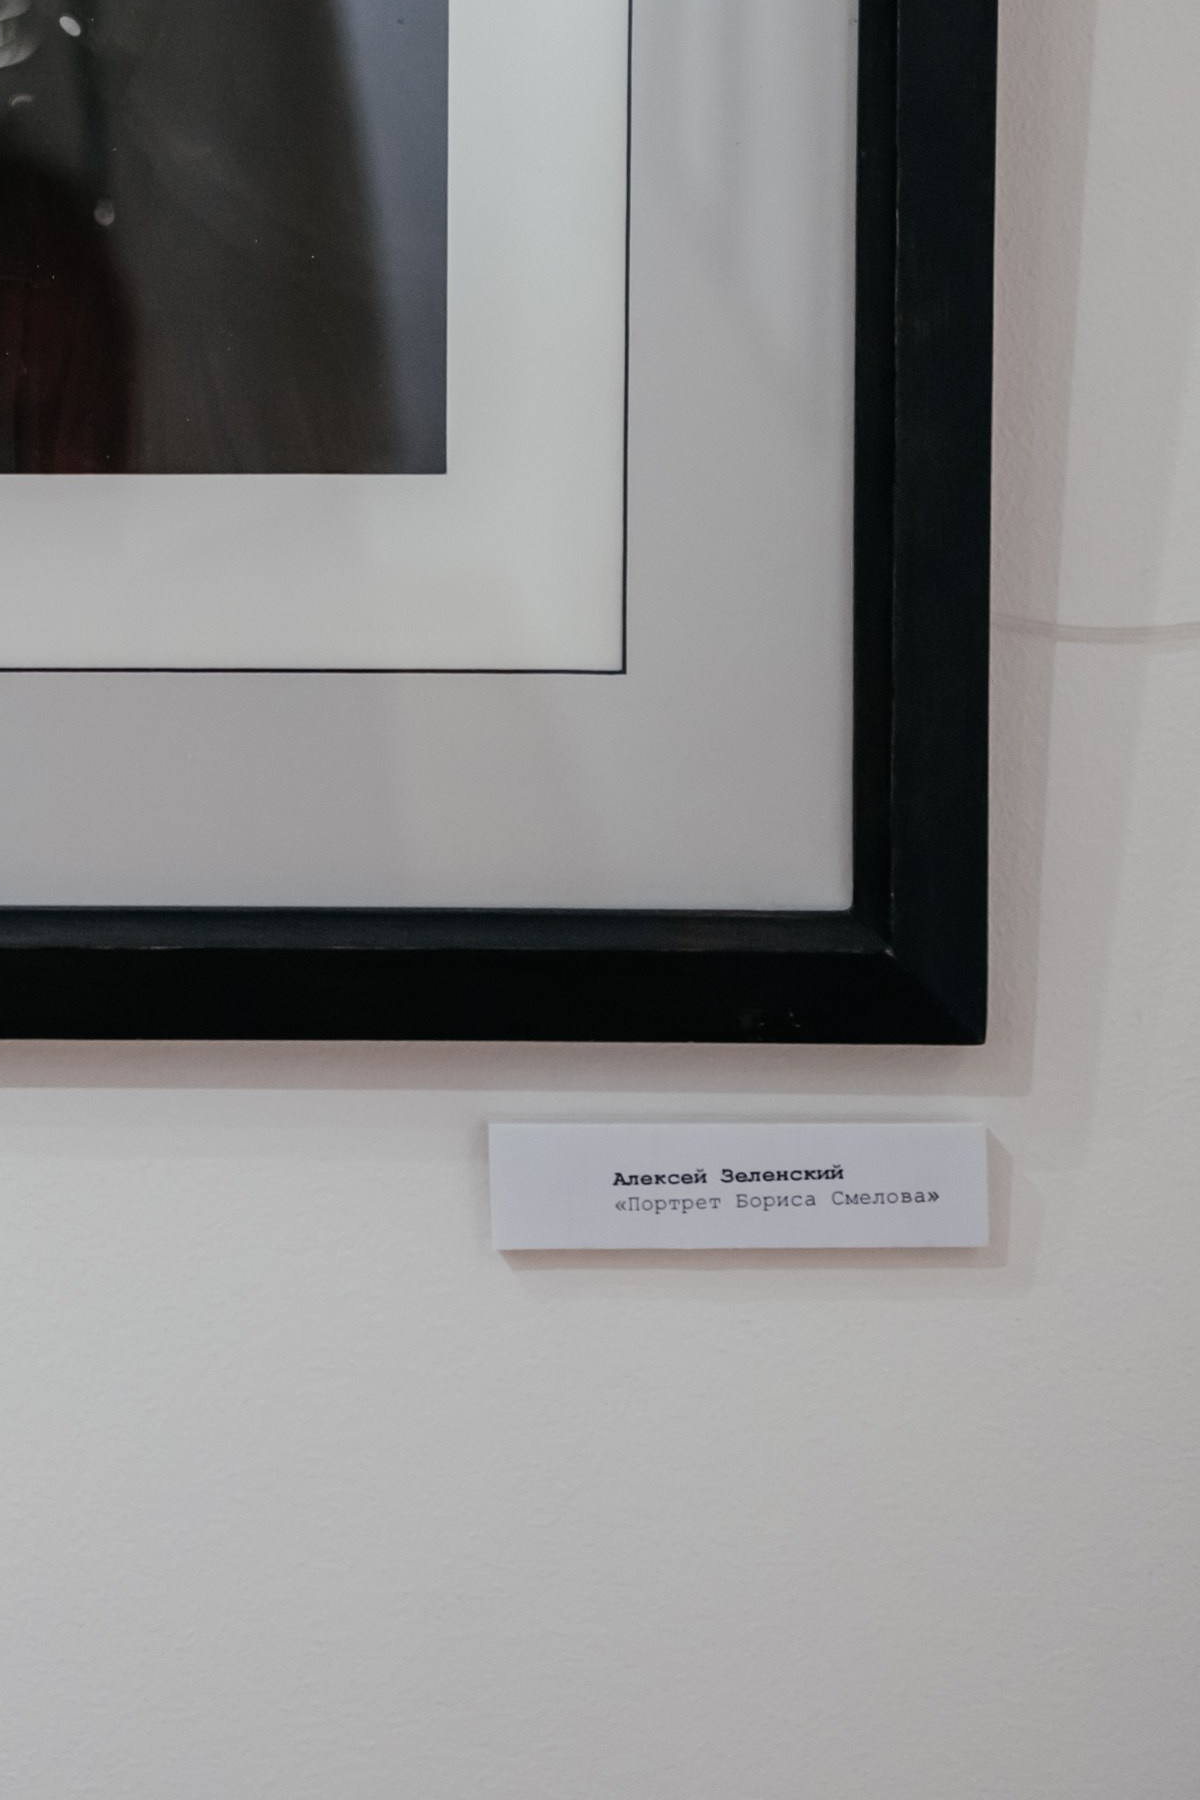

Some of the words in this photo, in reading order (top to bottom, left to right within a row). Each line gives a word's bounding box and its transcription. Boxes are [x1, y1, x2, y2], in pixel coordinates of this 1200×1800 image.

[612, 1168, 708, 1187] Алексей
[720, 1164, 844, 1184] Зеленский
[614, 1195, 722, 1215] «Портрет
[735, 1193, 817, 1211] Бориса
[831, 1190, 941, 1206] Смелова»
